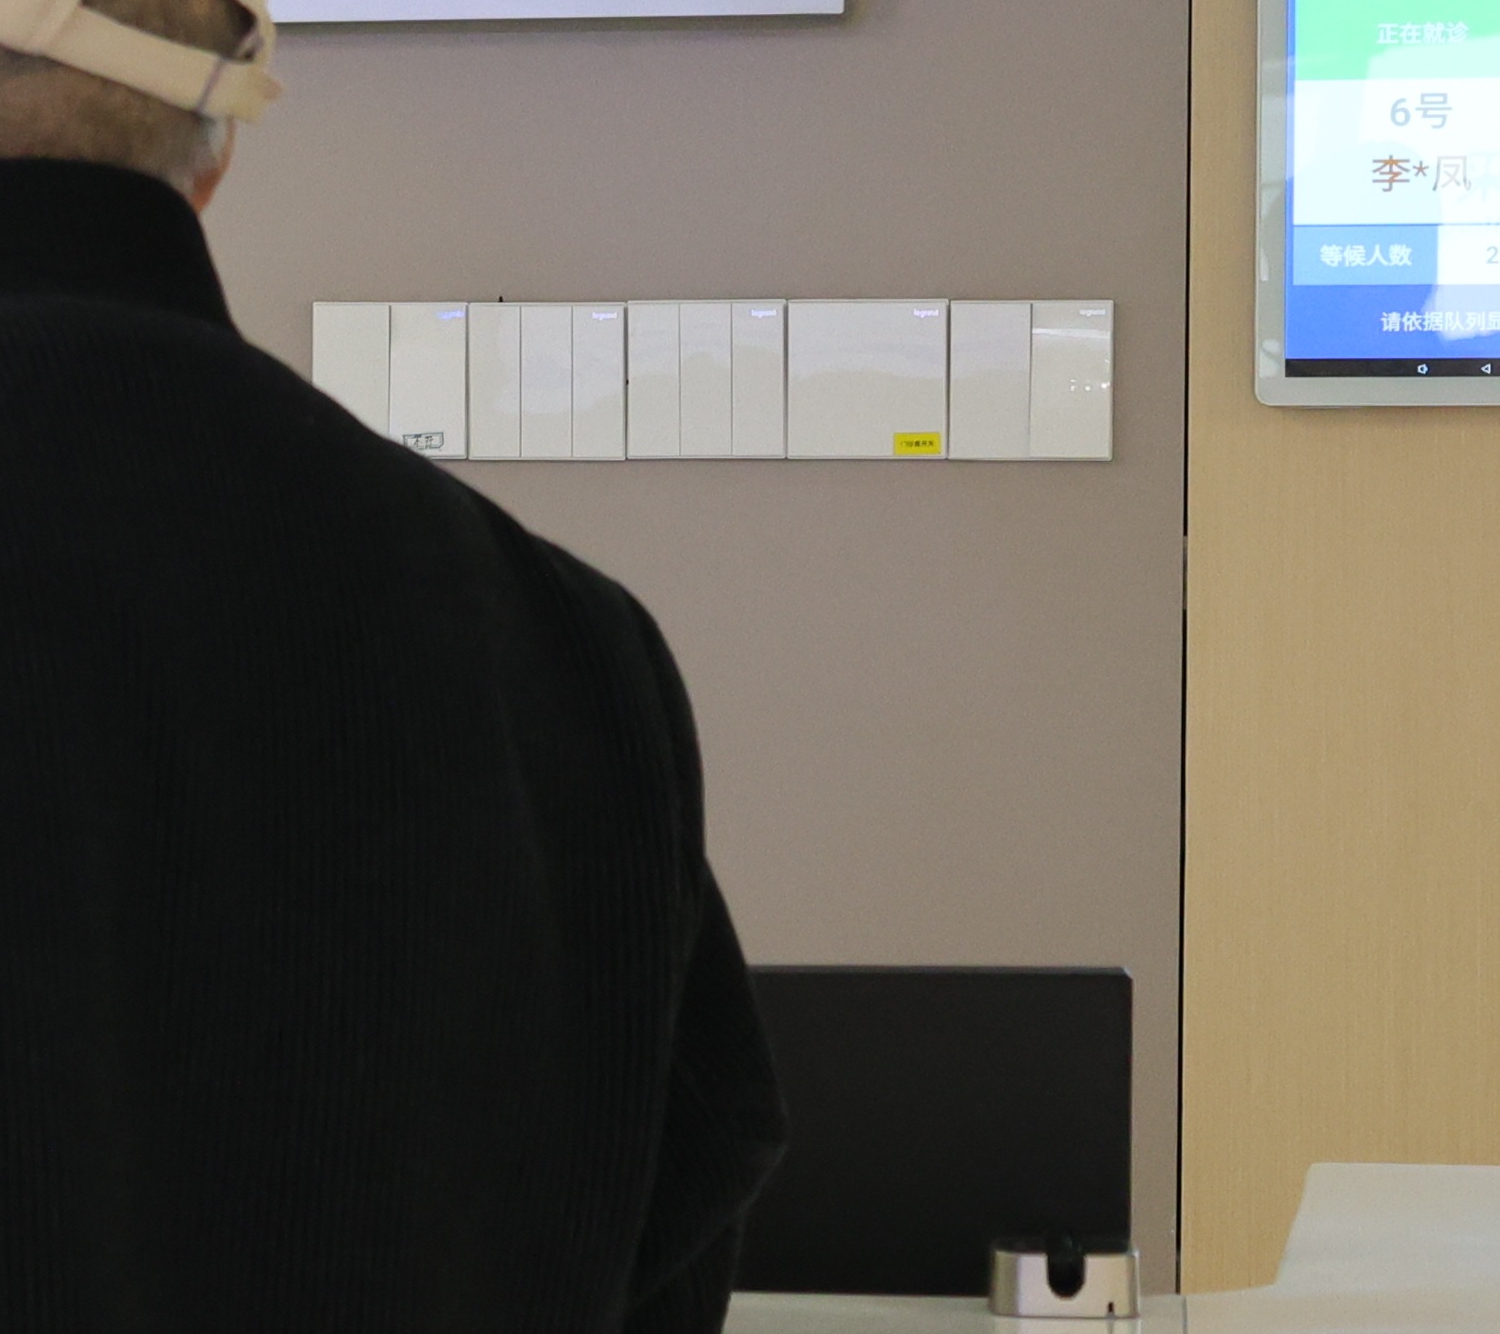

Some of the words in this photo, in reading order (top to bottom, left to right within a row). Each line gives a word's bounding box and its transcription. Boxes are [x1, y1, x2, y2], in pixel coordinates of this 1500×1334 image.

[1376, 21, 1469, 44] 正在就诊
[1389, 92, 1453, 129] 6号
[1319, 243, 1412, 267] 等候人数
